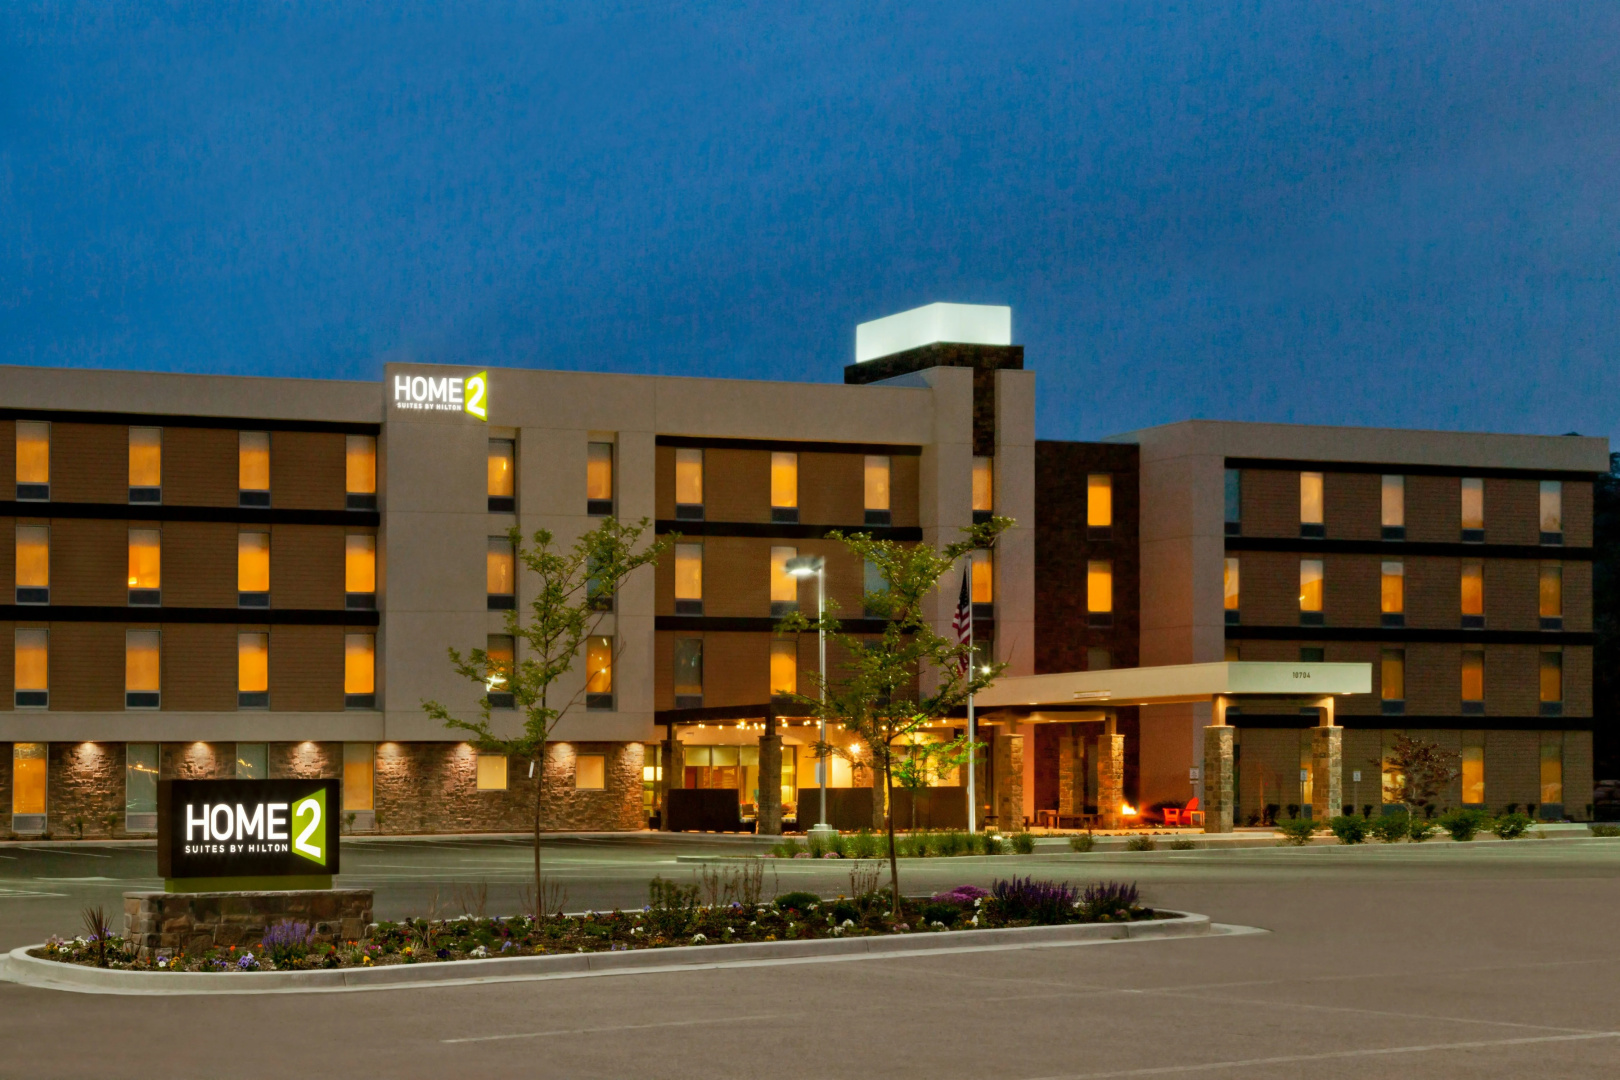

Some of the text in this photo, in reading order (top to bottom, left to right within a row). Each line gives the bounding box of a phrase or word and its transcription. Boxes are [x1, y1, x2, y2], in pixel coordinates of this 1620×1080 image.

[394, 375, 485, 417] HOME 2
[436, 403, 462, 411] HILTON
[1292, 671, 1311, 679] 10704
[186, 798, 321, 859] HOME 2
[185, 843, 288, 853] SUITES BY HILTON
